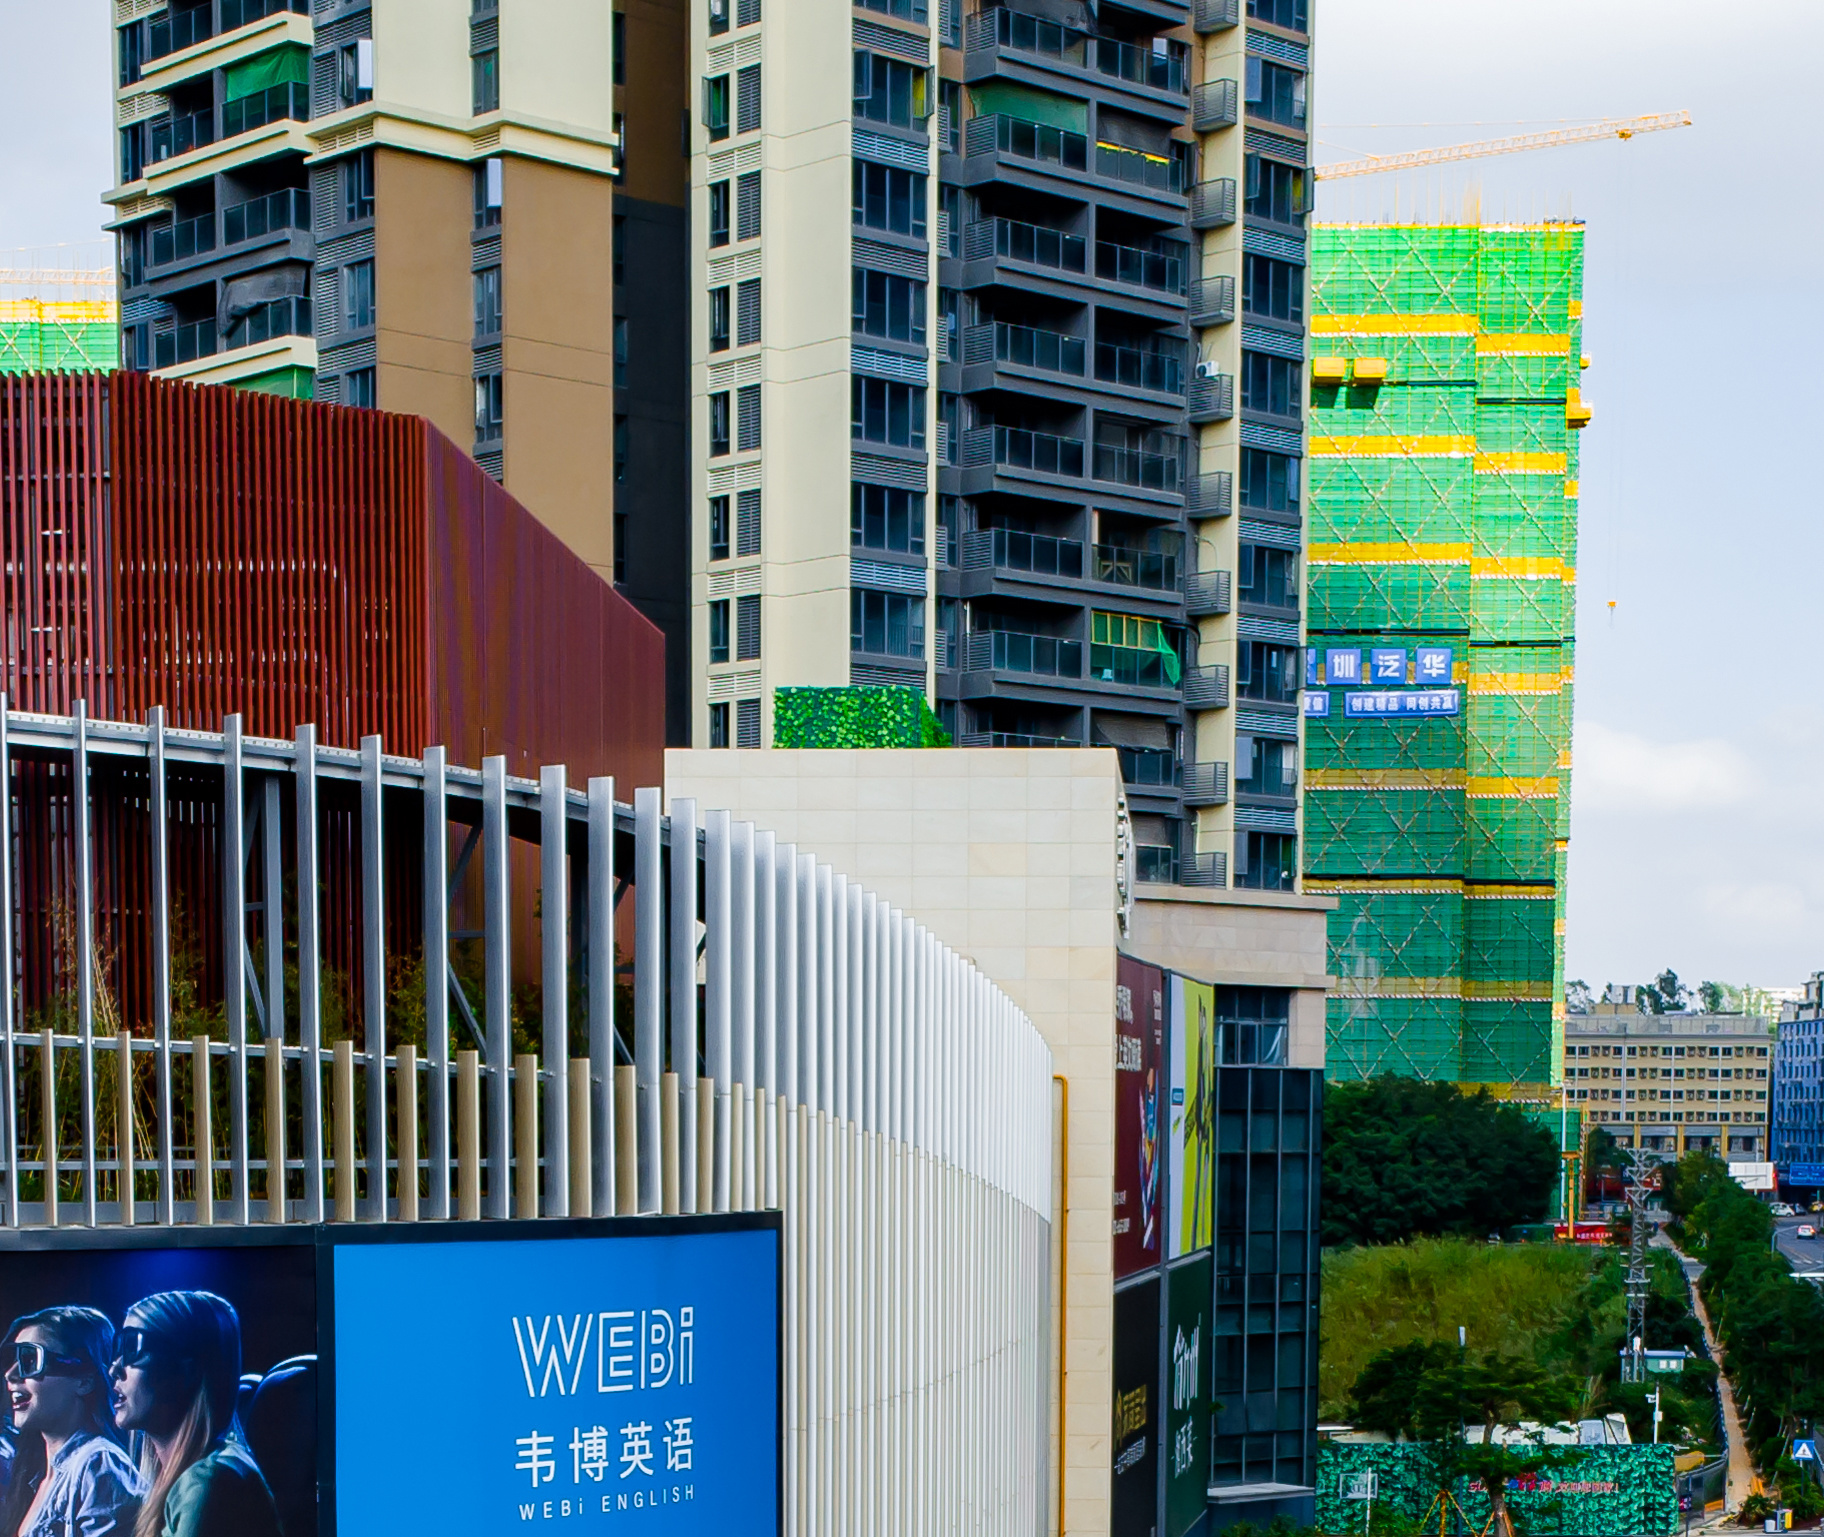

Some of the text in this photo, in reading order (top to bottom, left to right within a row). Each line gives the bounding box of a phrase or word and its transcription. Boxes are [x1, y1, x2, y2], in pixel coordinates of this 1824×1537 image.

[1307, 654, 1446, 678] 圳泛华
[514, 1416, 695, 1488] 韦博英语
[518, 1484, 695, 1521] WEBi ENGLISH
